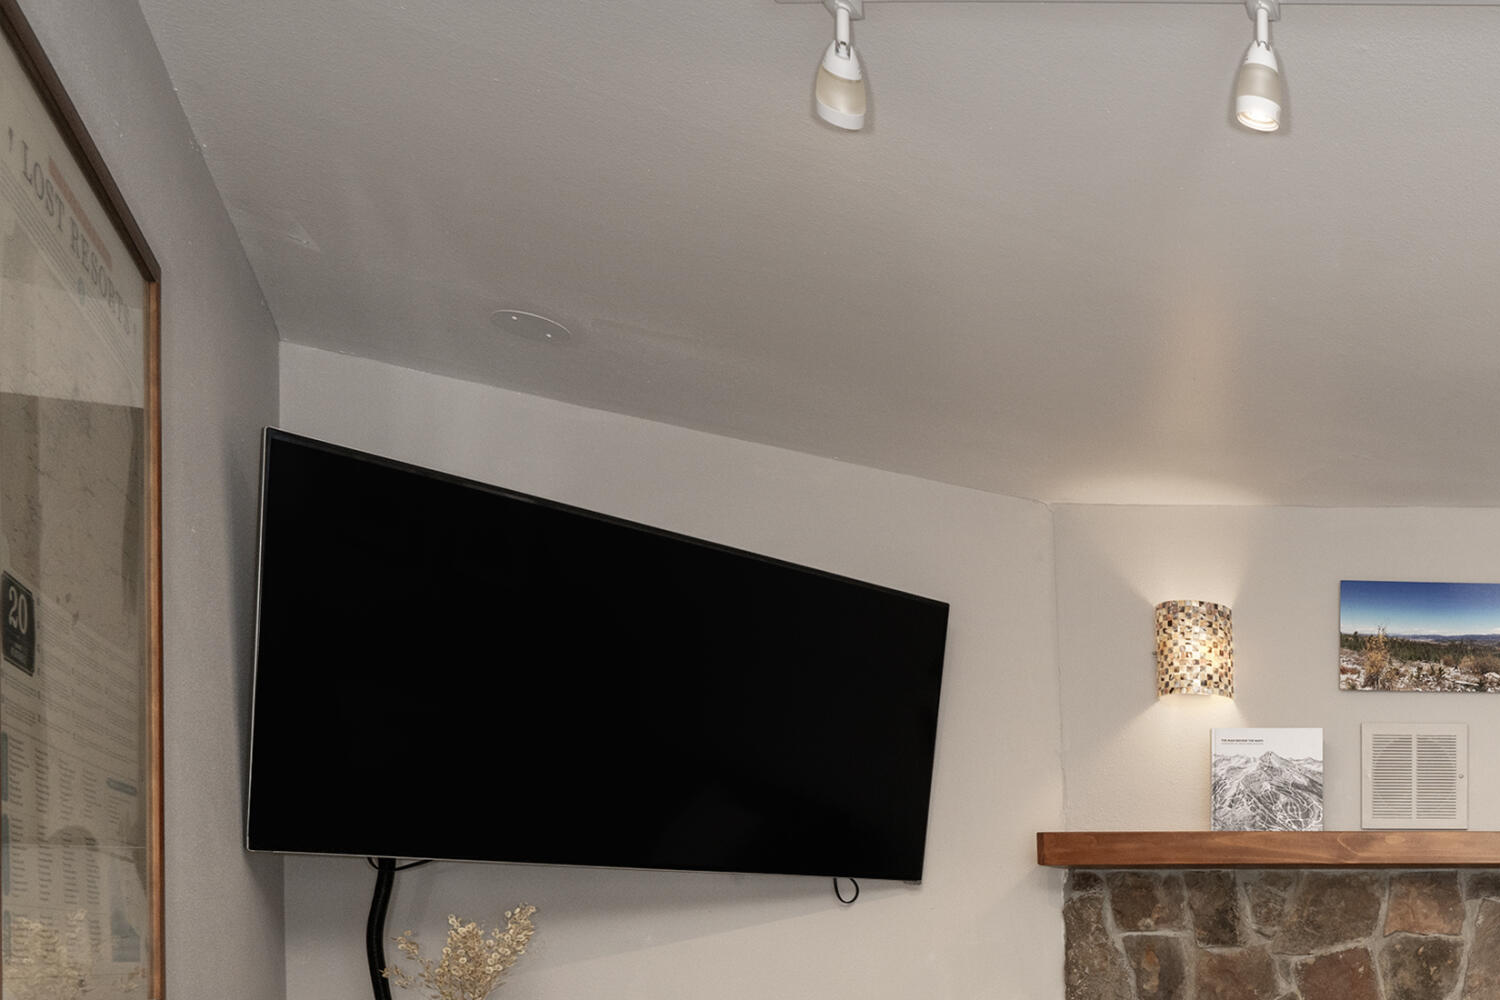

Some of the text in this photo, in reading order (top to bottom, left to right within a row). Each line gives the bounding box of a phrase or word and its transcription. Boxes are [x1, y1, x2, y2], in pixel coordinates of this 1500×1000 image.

[22, 140, 65, 232] LOST
[70, 216, 131, 335] RESORTS
[8, 585, 28, 635] 20
